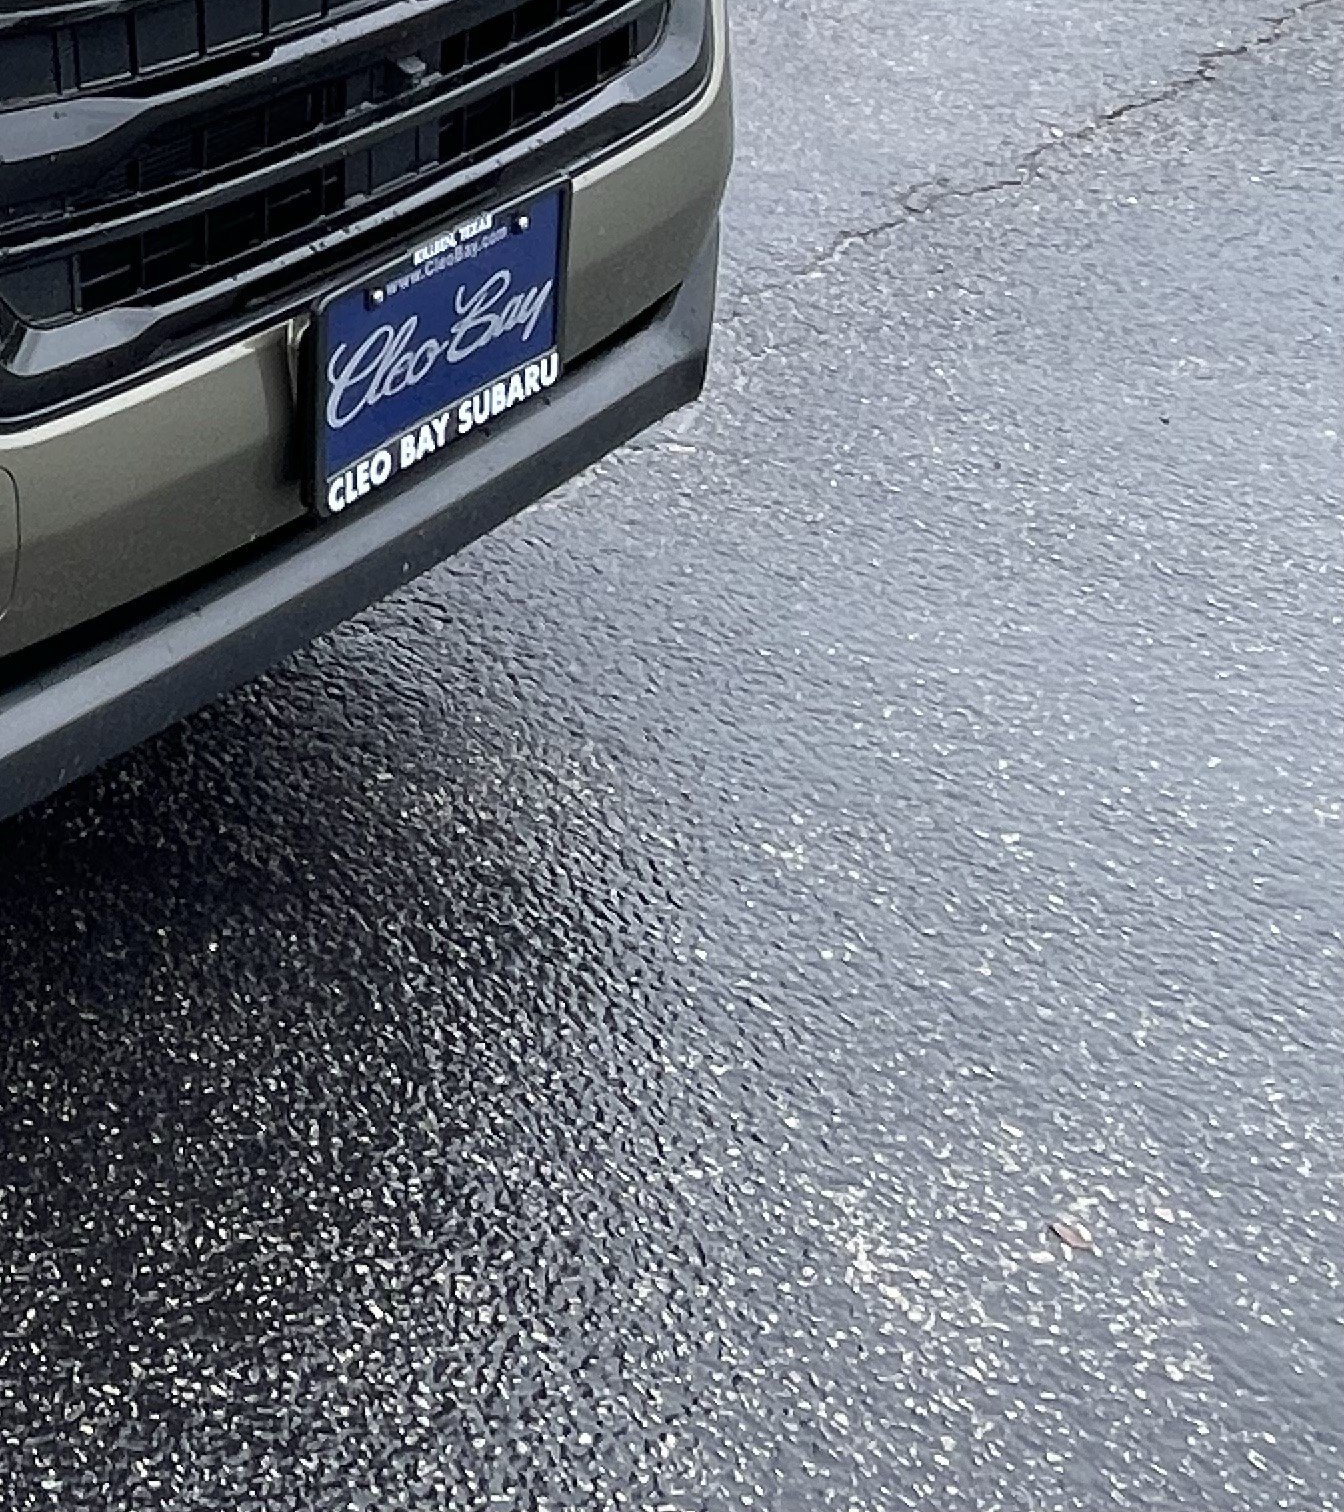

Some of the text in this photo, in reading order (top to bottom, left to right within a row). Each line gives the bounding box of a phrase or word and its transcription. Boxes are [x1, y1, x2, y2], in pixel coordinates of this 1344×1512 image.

[326, 270, 553, 428] Cleo Bay
[327, 351, 559, 513] CLEO BAY SUBARU
